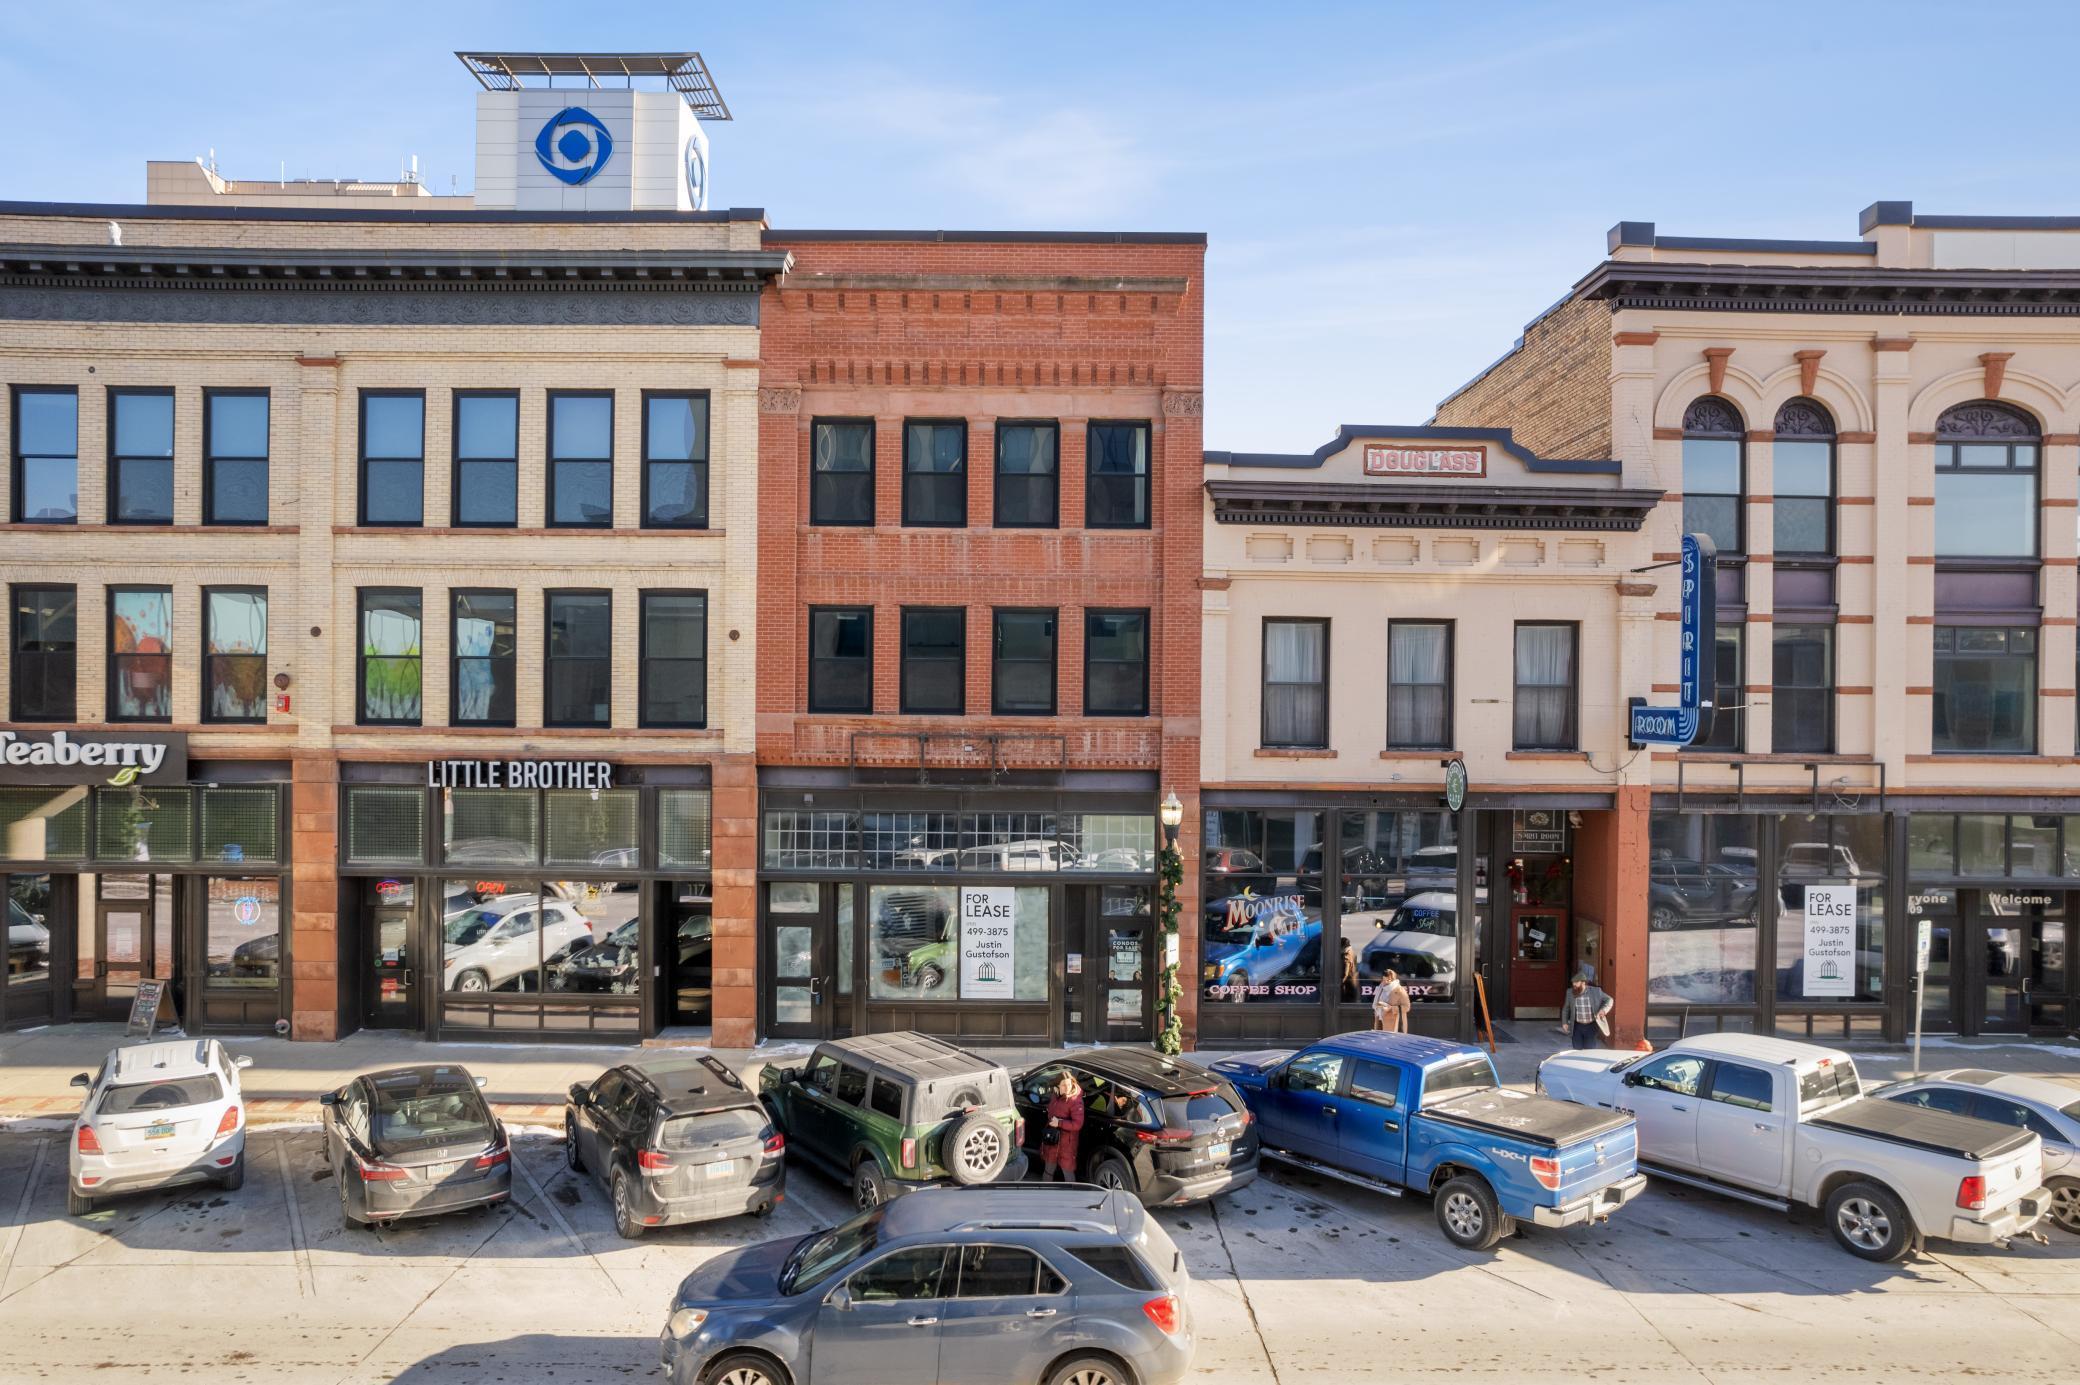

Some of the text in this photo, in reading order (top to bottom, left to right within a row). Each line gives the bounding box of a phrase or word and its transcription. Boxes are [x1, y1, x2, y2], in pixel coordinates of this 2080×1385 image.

[1371, 451, 1478, 471] DOUGLASS
[1682, 552, 1695, 703] SPIRIT
[1634, 715, 1677, 737] ROOM
[428, 760, 611, 789] LITTLE BROTHER
[476, 881, 506, 893] OPEN
[966, 894, 989, 904] FOR
[1809, 893, 1832, 903] FOR
[1988, 894, 2052, 905] Welcome
[966, 905, 1010, 918] LEASE
[1221, 894, 1305, 932] MOONRISE
[1414, 909, 1440, 917] COFFEE
[1809, 903, 1852, 916] LEASE
[967, 927, 1009, 936] 499-3875
[1809, 925, 1850, 934] 499-3875
[975, 940, 1002, 949] Justin
[1818, 938, 1844, 947] Justin
[965, 950, 1010, 959] Gustofson
[1808, 948, 1851, 957] Gustofson
[1209, 985, 1317, 995] COFFEE SHOP
